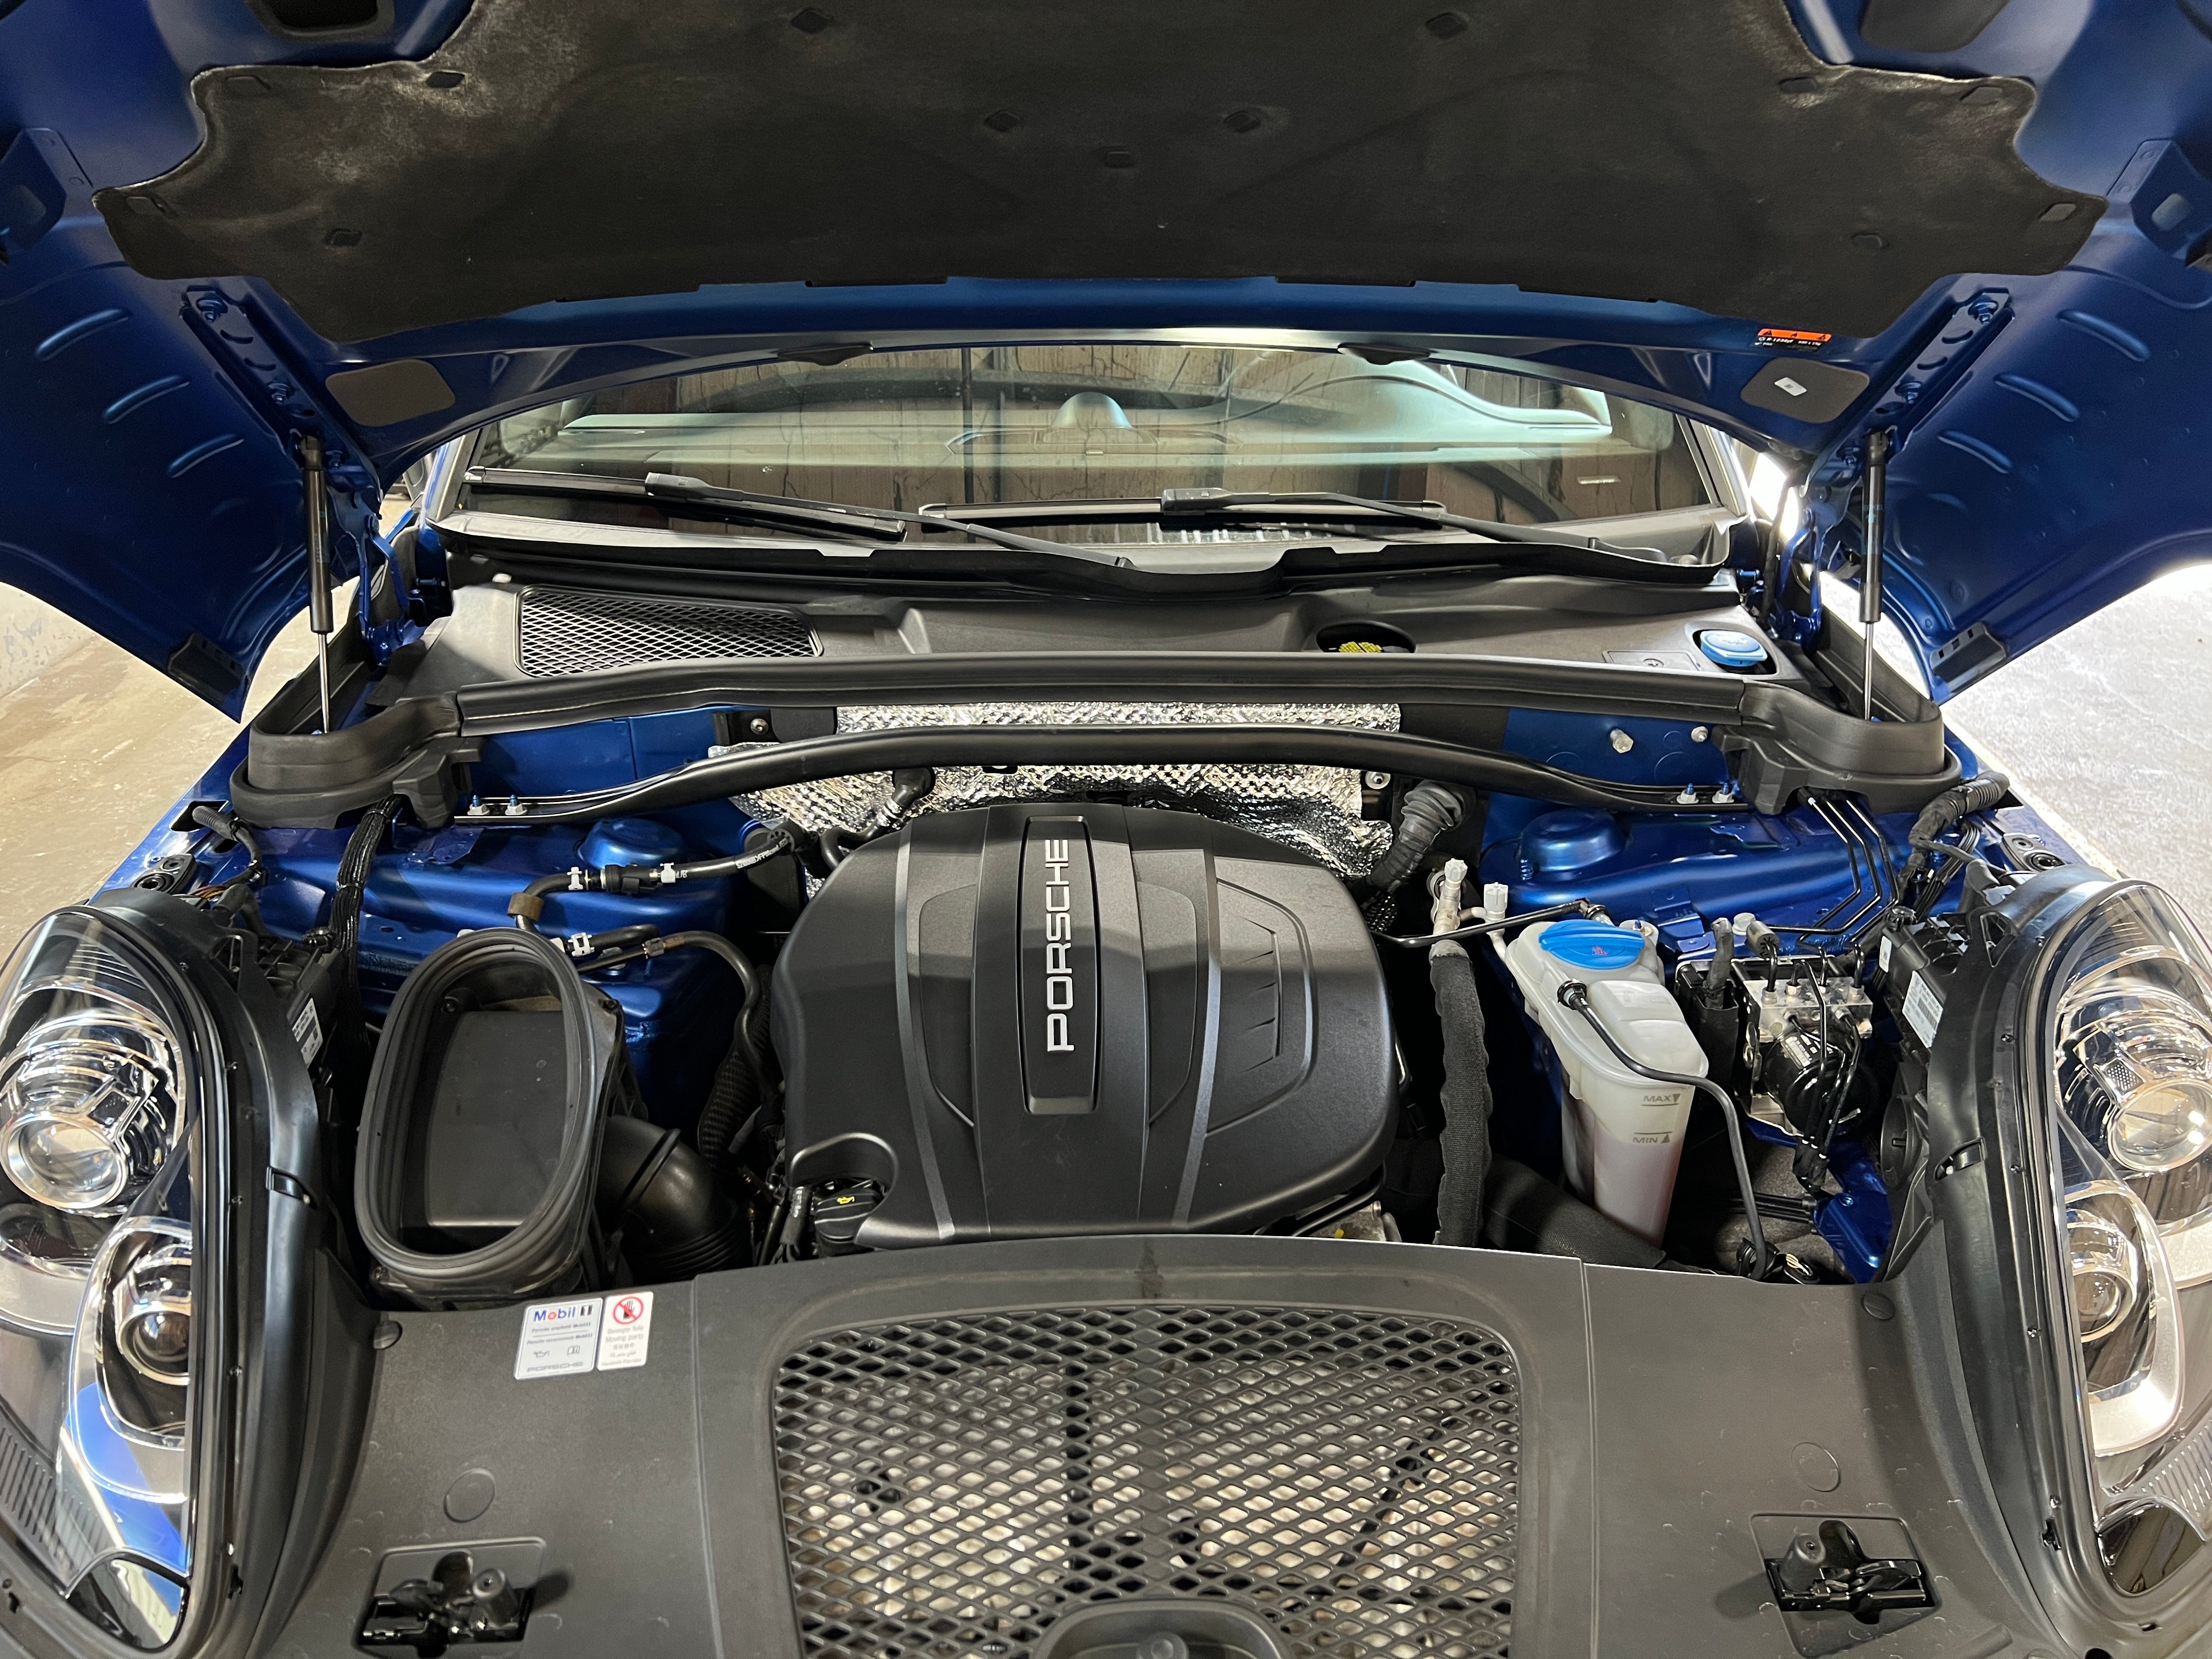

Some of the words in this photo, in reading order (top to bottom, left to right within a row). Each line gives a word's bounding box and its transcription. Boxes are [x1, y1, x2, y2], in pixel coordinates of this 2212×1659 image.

[1045, 839, 1074, 1052] PORSCHE
[533, 1307, 575, 1322] Mobil
[527, 1361, 584, 1373] PORSCHE
